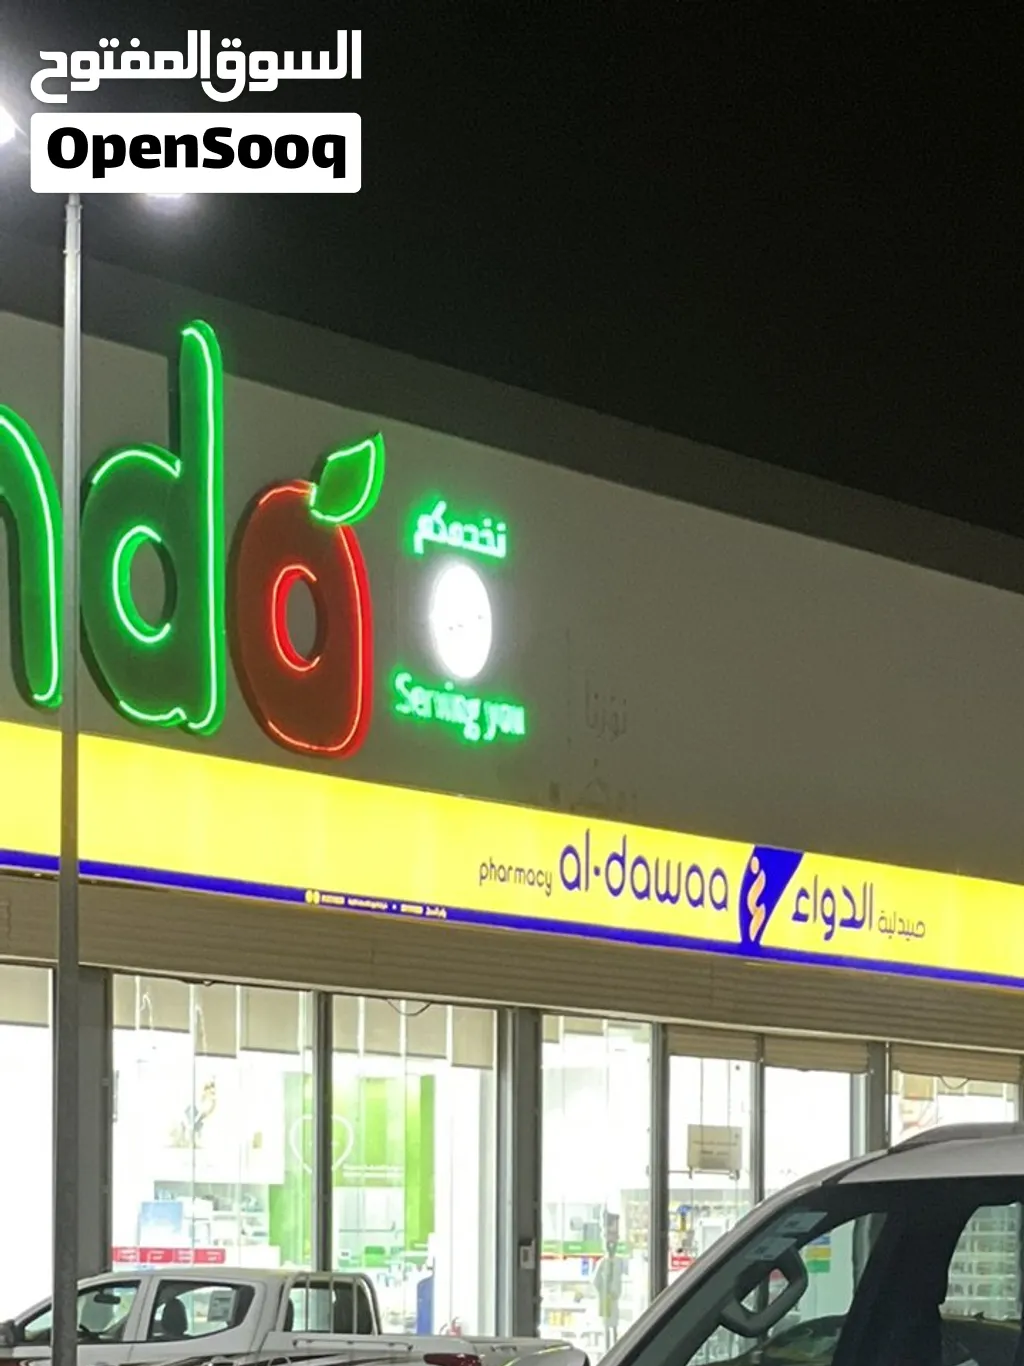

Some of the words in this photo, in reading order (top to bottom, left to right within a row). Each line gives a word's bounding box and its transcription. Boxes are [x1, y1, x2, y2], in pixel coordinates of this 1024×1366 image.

[395, 672, 481, 741] Serving
[483, 701, 526, 741] you
[479, 857, 552, 897] pharmacy
[792, 874, 874, 941] الدواء
[878, 909, 926, 941] صيدلية
